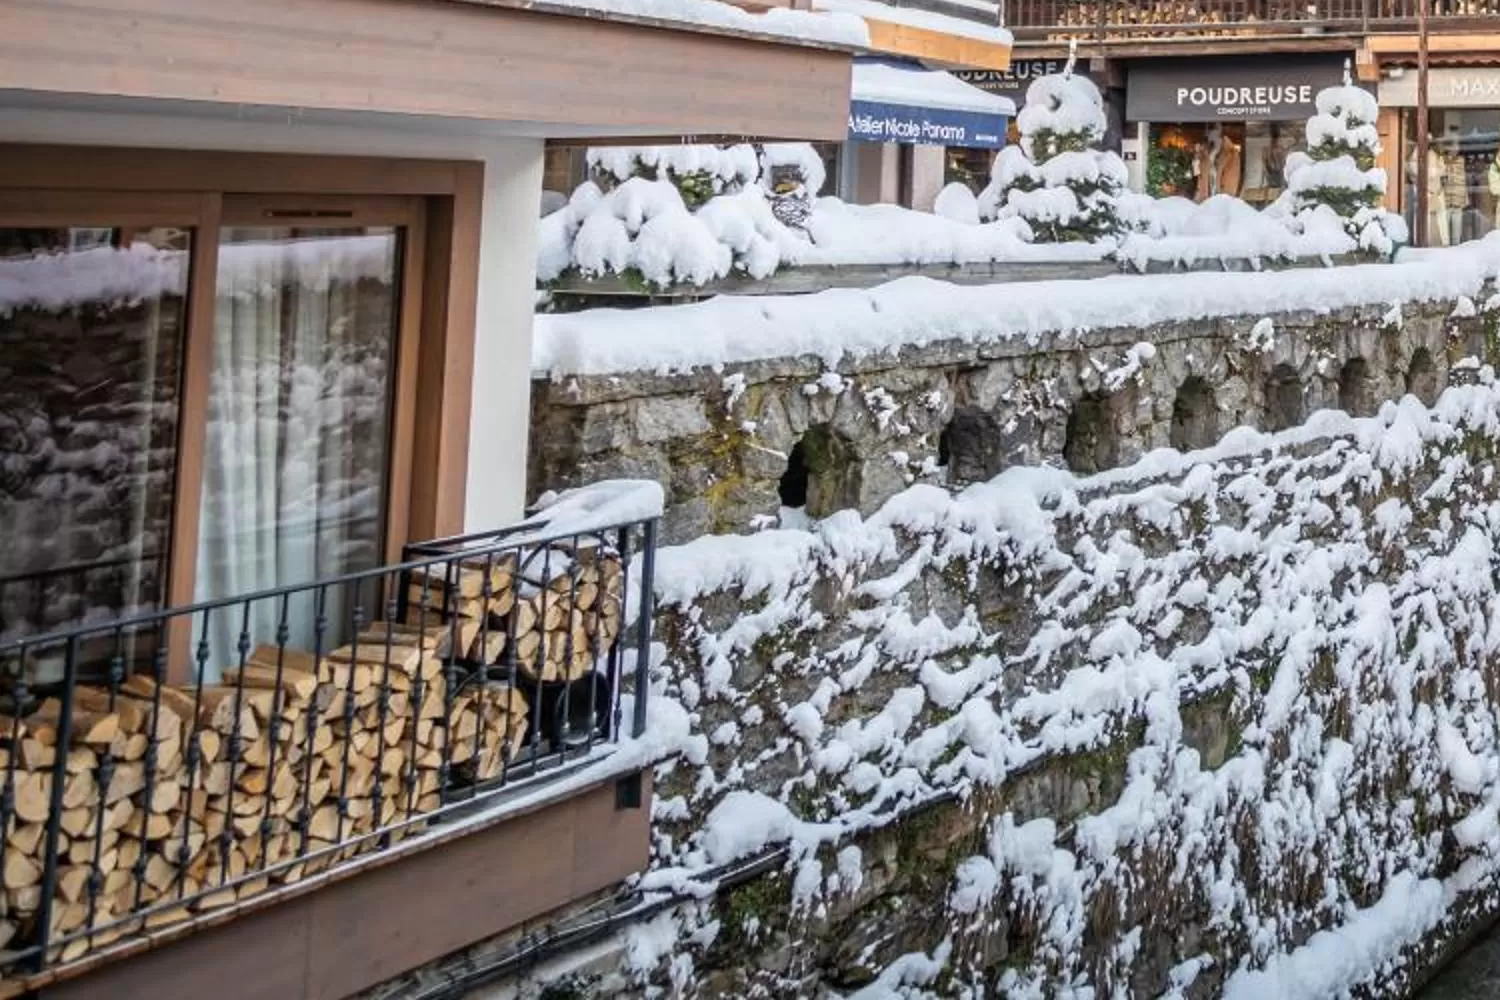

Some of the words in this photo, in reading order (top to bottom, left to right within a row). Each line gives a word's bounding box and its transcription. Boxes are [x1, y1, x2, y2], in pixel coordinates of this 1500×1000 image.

[1177, 85, 1311, 105] POUDREUSE
[1450, 75, 1499, 97] MAX
[885, 116, 921, 138] Nicole
